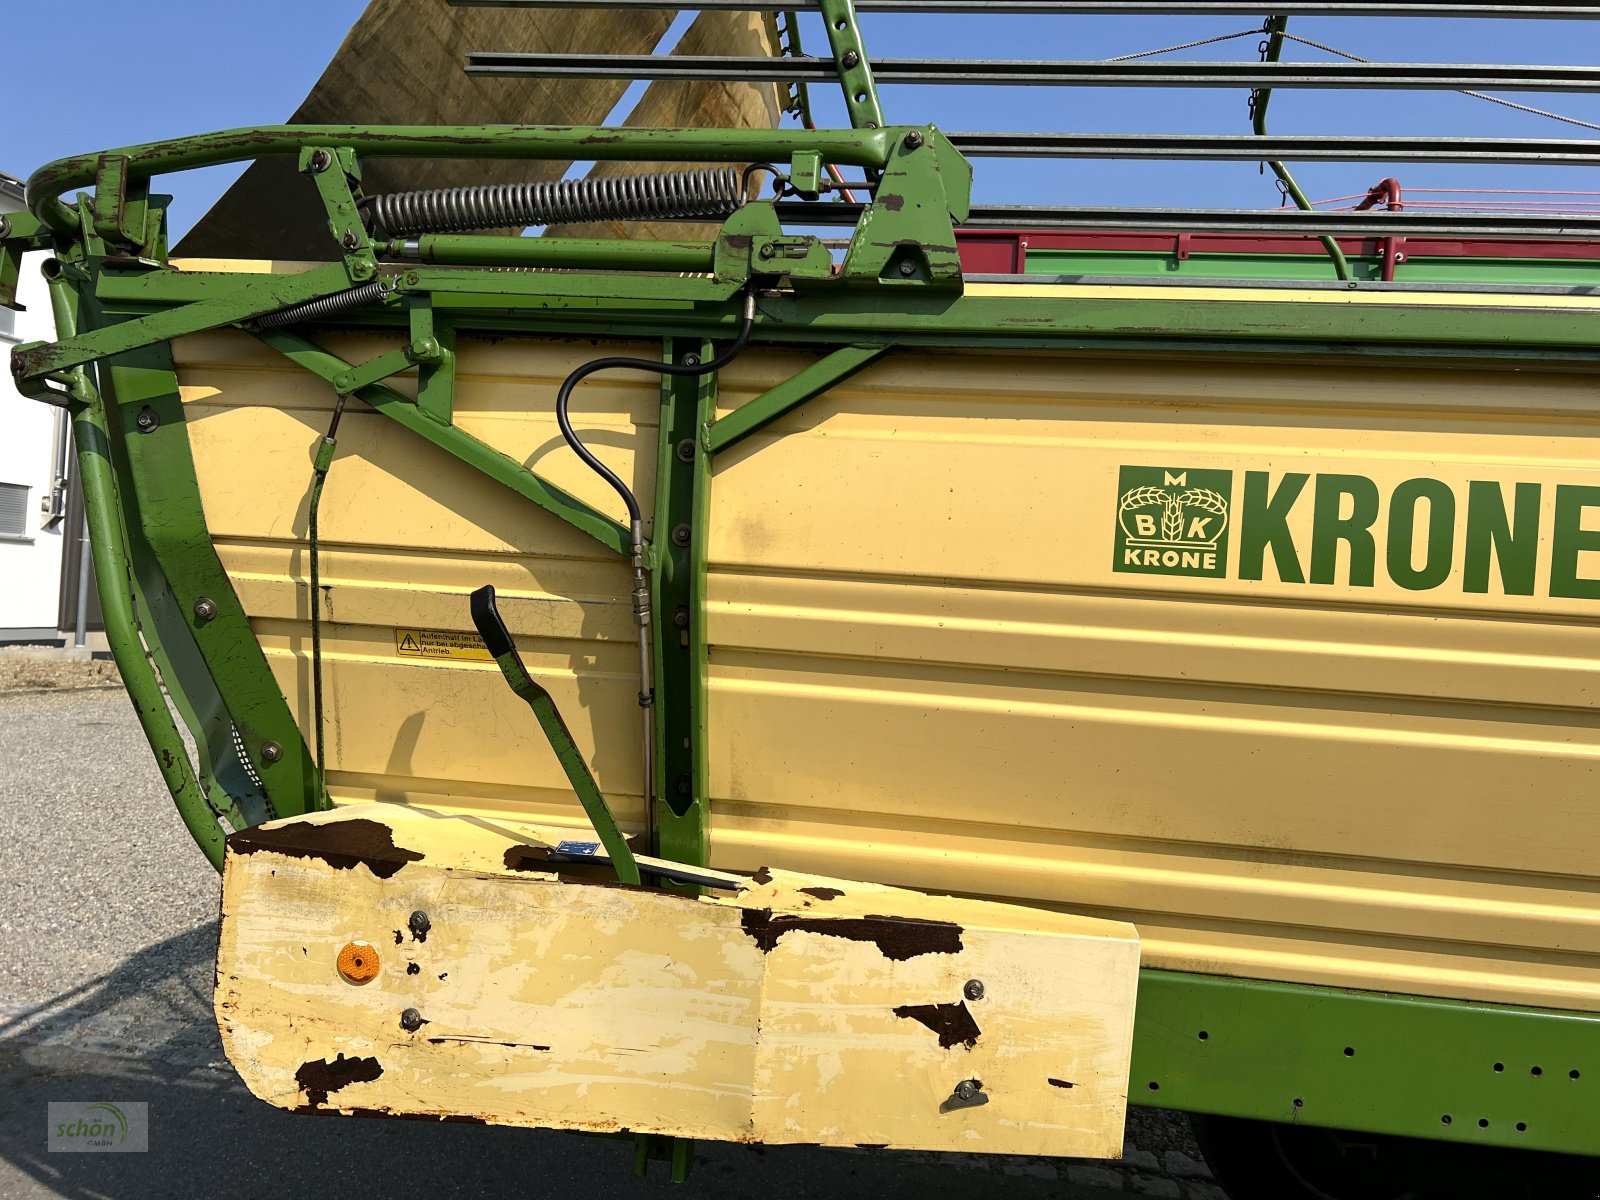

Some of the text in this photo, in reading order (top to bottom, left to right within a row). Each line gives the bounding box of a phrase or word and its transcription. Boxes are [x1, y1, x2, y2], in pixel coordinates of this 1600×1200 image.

[1164, 470, 1187, 487] M
[1135, 514, 1213, 539] B K
[1238, 470, 1600, 600] KRONE
[1124, 549, 1217, 570] KRONE
[421, 633, 460, 641] Aufenthalt
[423, 647, 452, 655] Antrieb.
